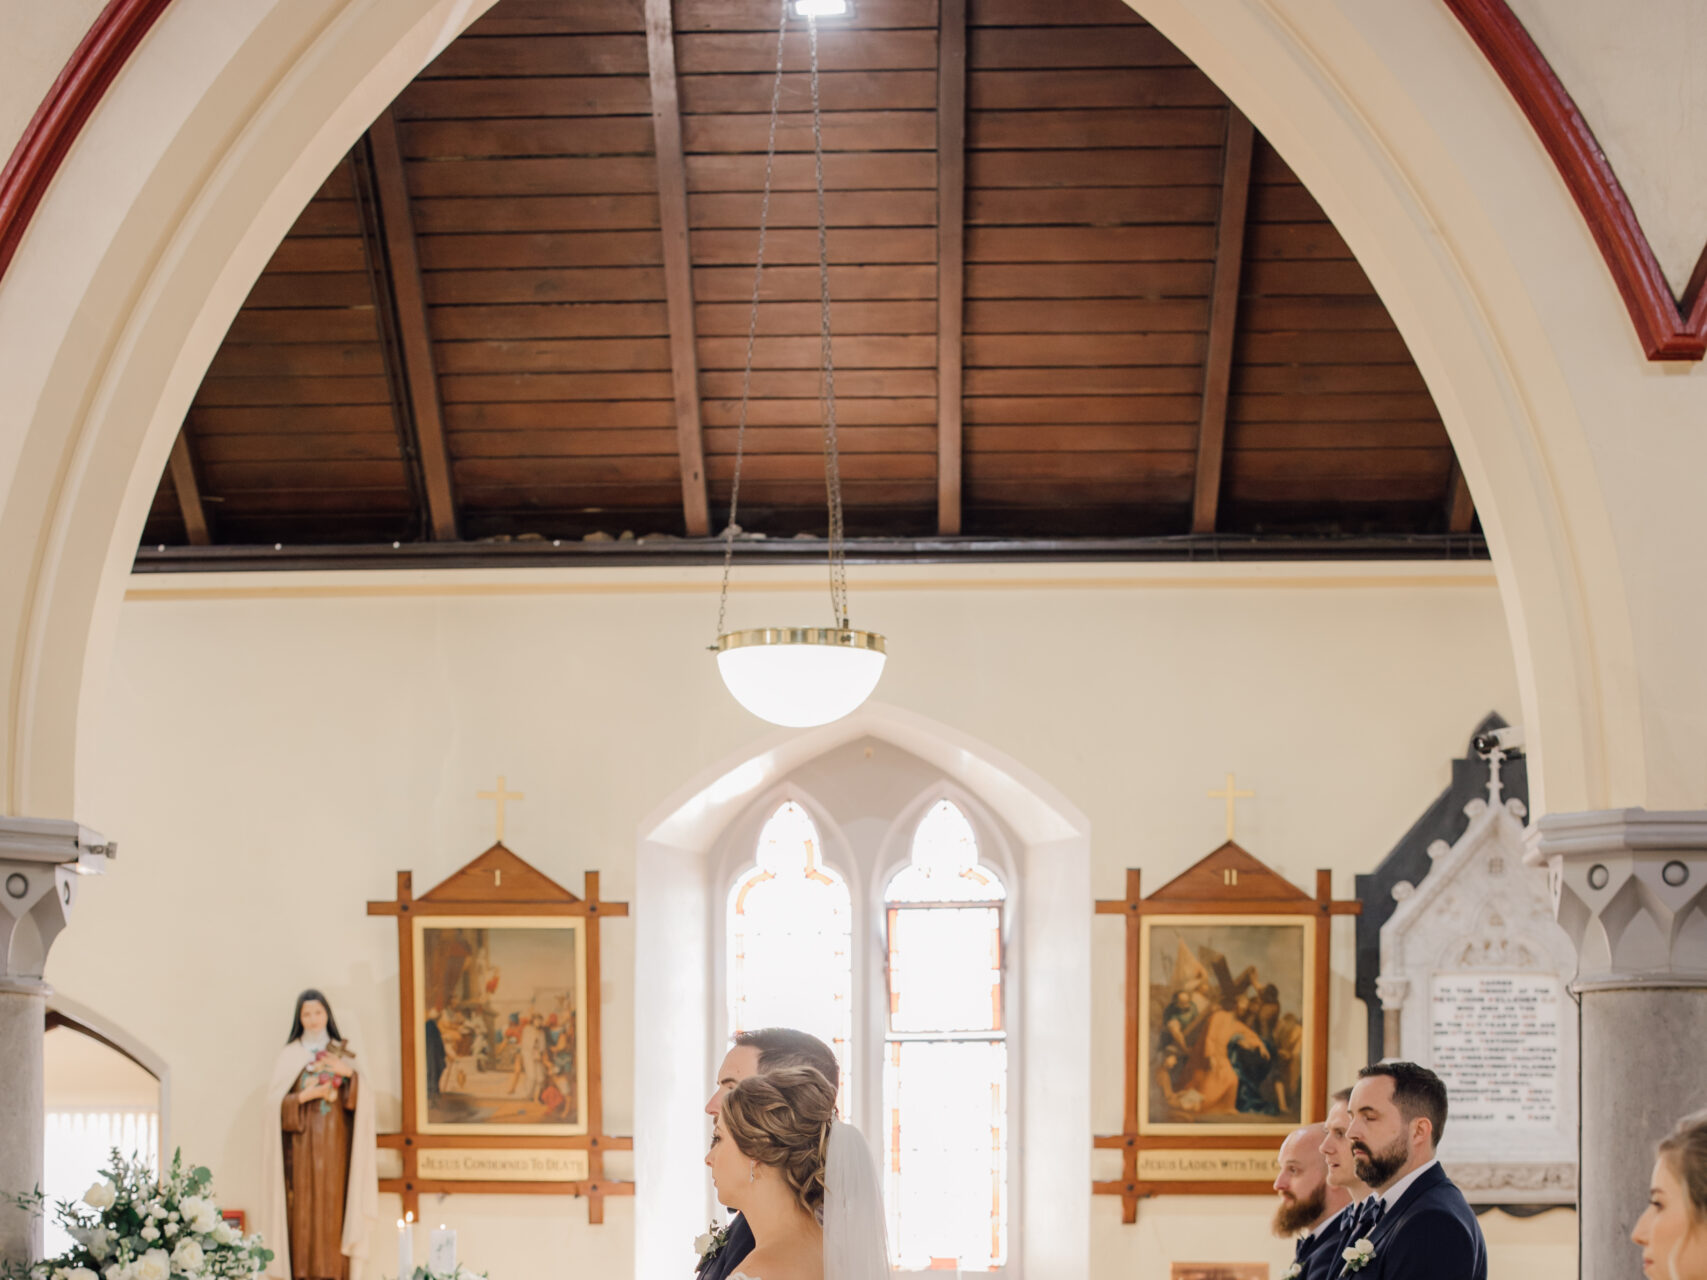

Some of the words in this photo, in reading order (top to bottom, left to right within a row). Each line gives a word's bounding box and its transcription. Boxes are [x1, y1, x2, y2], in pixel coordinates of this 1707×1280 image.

[1224, 869, 1238, 886] II
[1141, 1158, 1176, 1170] JESUS
[1179, 1158, 1217, 1170] LADEN
